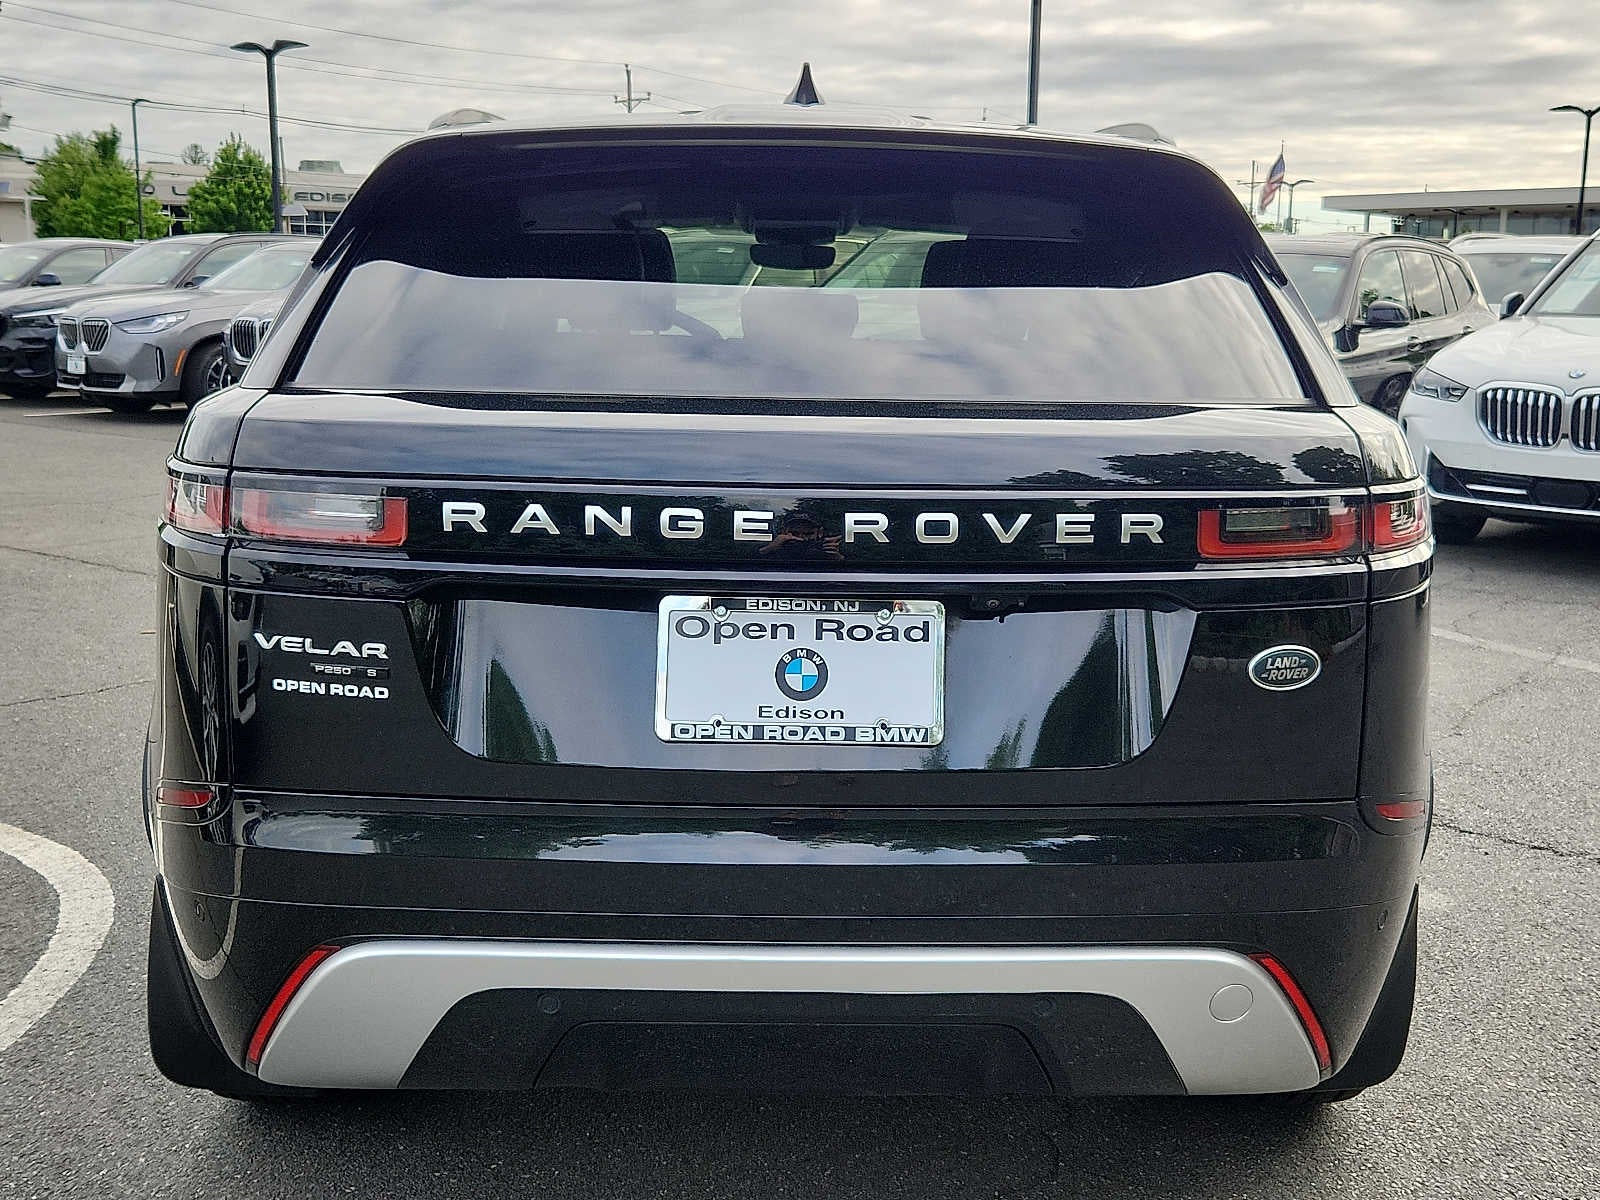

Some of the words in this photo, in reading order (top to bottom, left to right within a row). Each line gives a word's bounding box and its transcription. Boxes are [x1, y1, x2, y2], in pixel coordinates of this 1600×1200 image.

[442, 501, 775, 541] RANGE
[844, 512, 1164, 544] ROVER
[746, 600, 826, 611] EDISON,
[834, 601, 860, 611] NJ
[675, 616, 795, 644] Open
[815, 618, 930, 643] Road
[253, 632, 389, 659] VELAR
[782, 649, 824, 665] BMW
[1266, 656, 1300, 669] LAND
[315, 665, 351, 675] P250
[366, 669, 377, 677] S
[1268, 667, 1309, 681] ROVER
[272, 678, 326, 695] OPEN
[329, 683, 389, 699] ROAD
[758, 705, 845, 720] Edison
[674, 724, 754, 740] OPEN
[763, 725, 847, 741] ROAD
[855, 726, 926, 743] BMW
